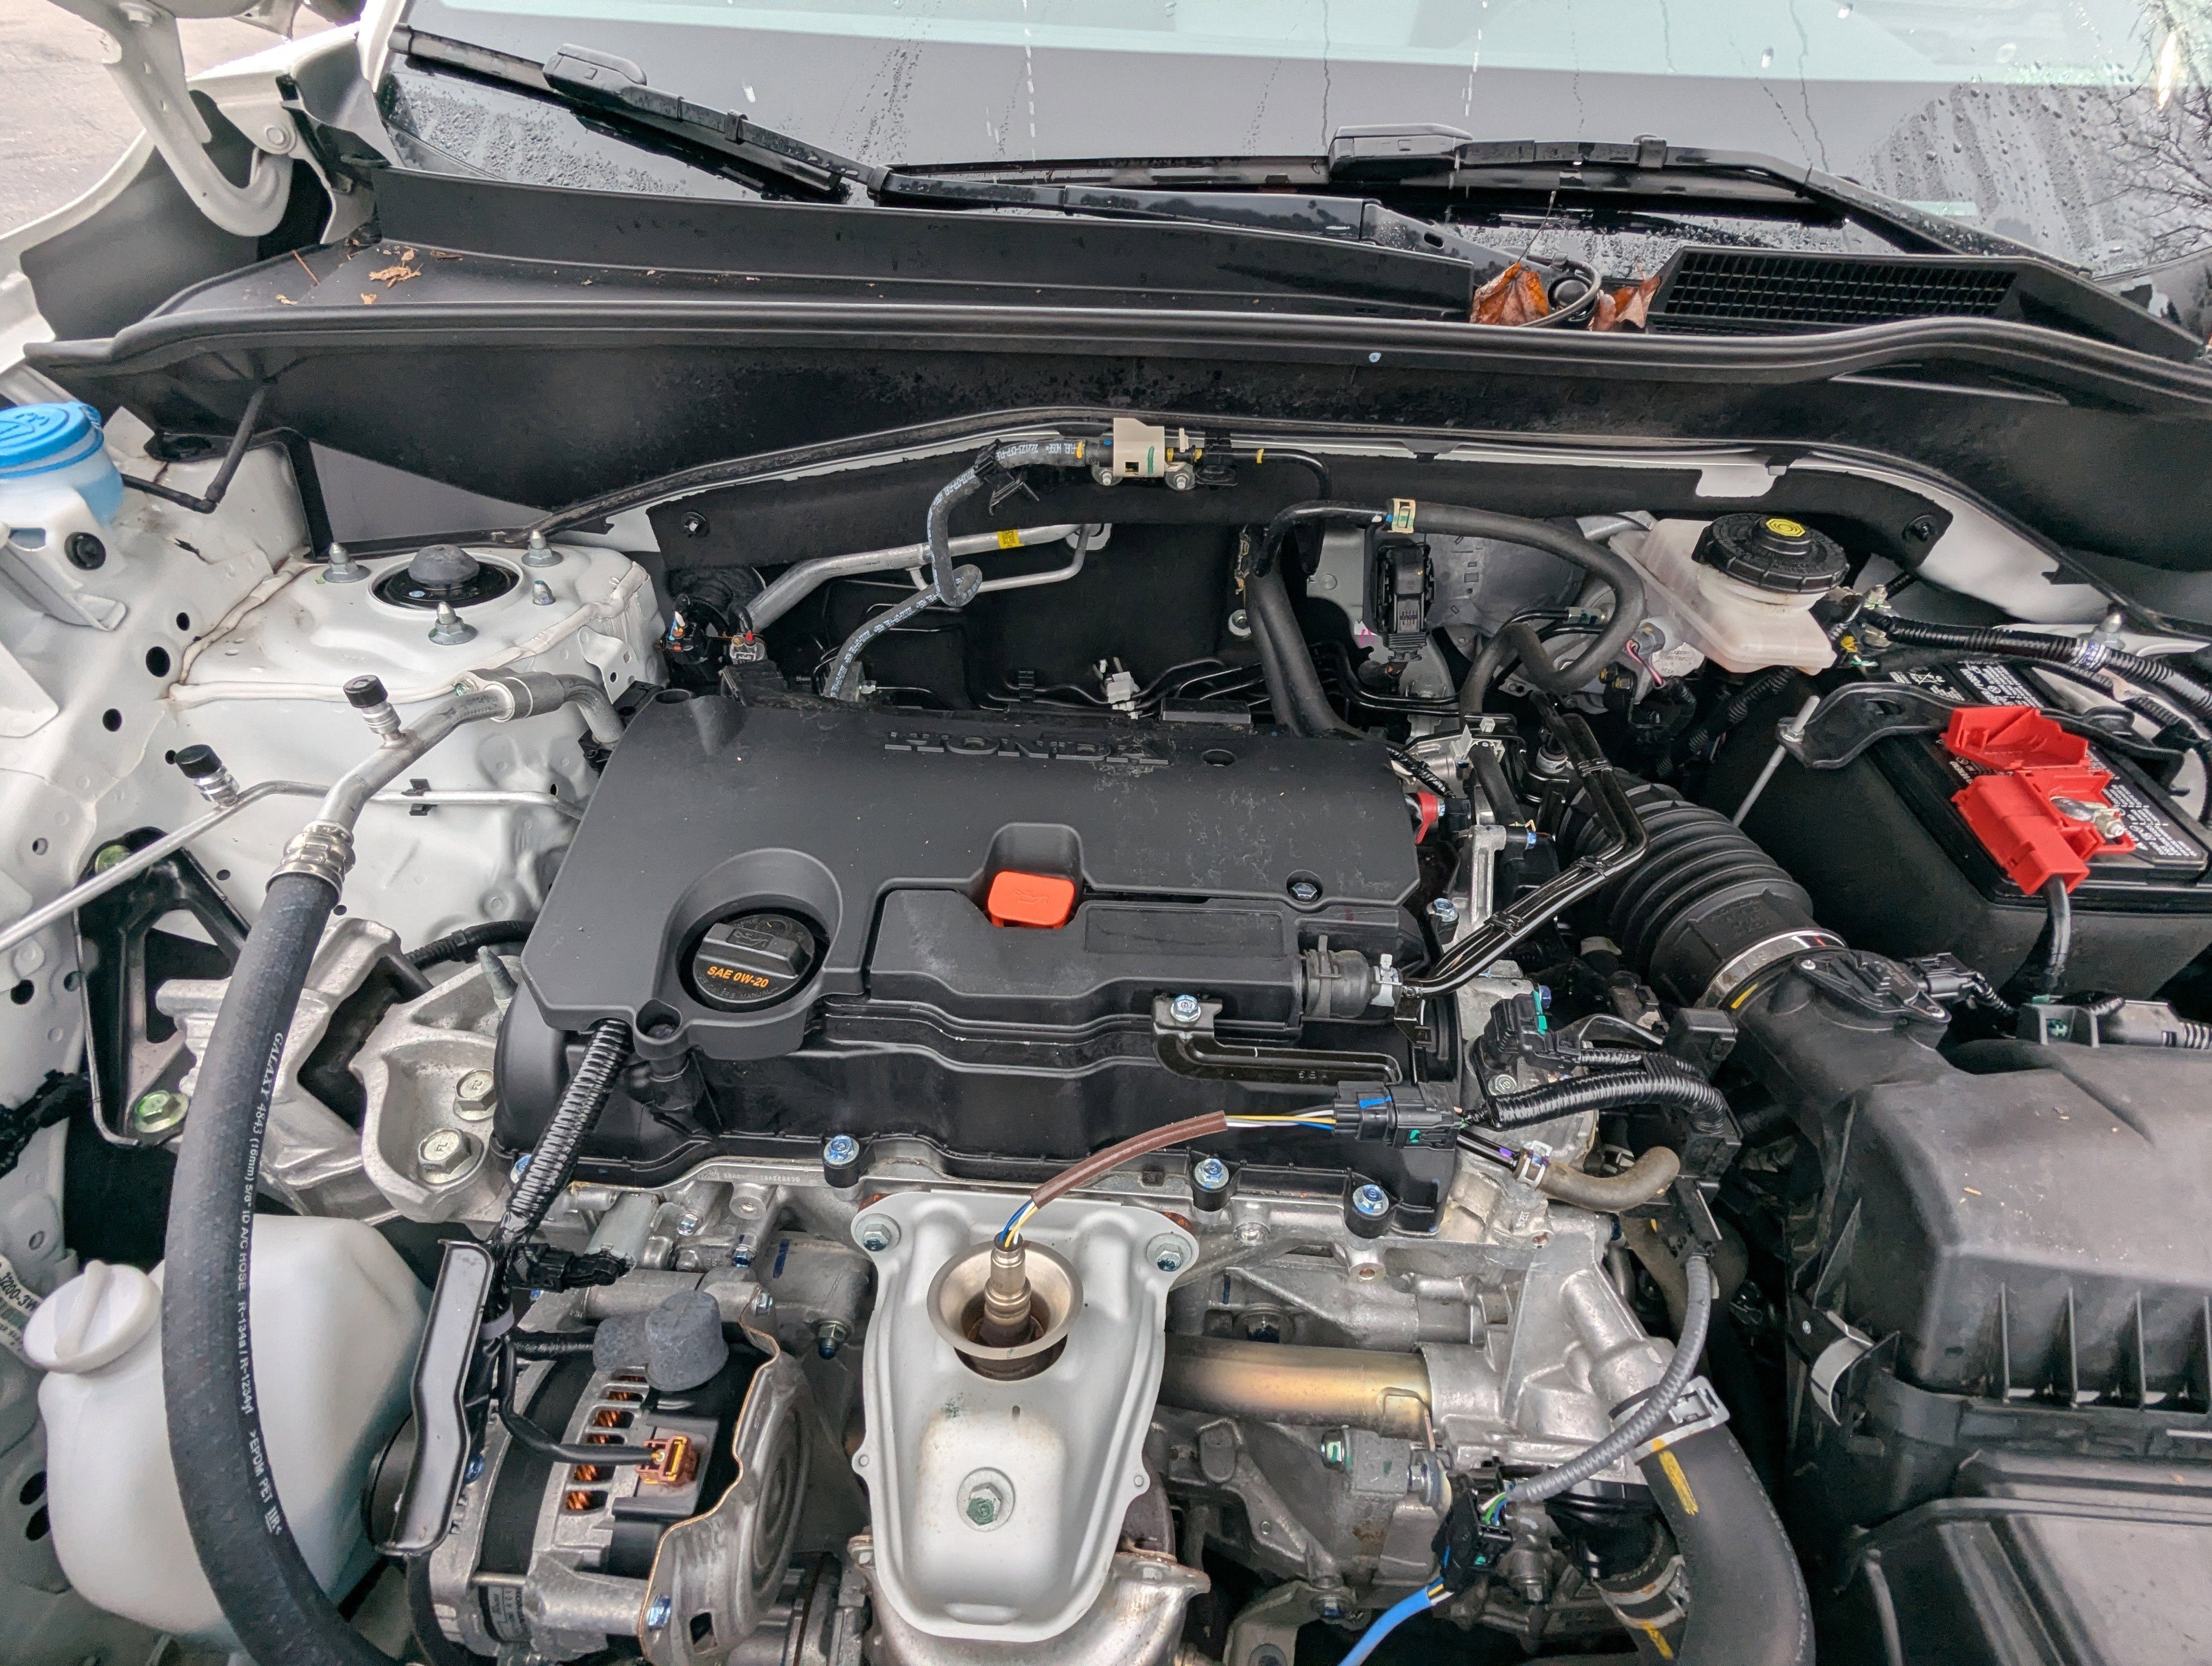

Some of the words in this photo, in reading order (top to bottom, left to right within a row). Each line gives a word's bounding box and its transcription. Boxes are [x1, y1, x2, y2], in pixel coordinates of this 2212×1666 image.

[706, 965, 734, 980] SAE
[732, 972, 770, 989] 0W-20
[261, 1032, 284, 1100] GALAXY
[253, 1103, 267, 1135] 4843
[245, 1138, 260, 1182] (16mm)
[241, 1210, 251, 1224] ID
[237, 1252, 247, 1292] HOSE
[237, 1302, 248, 1349] R-134a
[259, 1477, 274, 1504] PET
